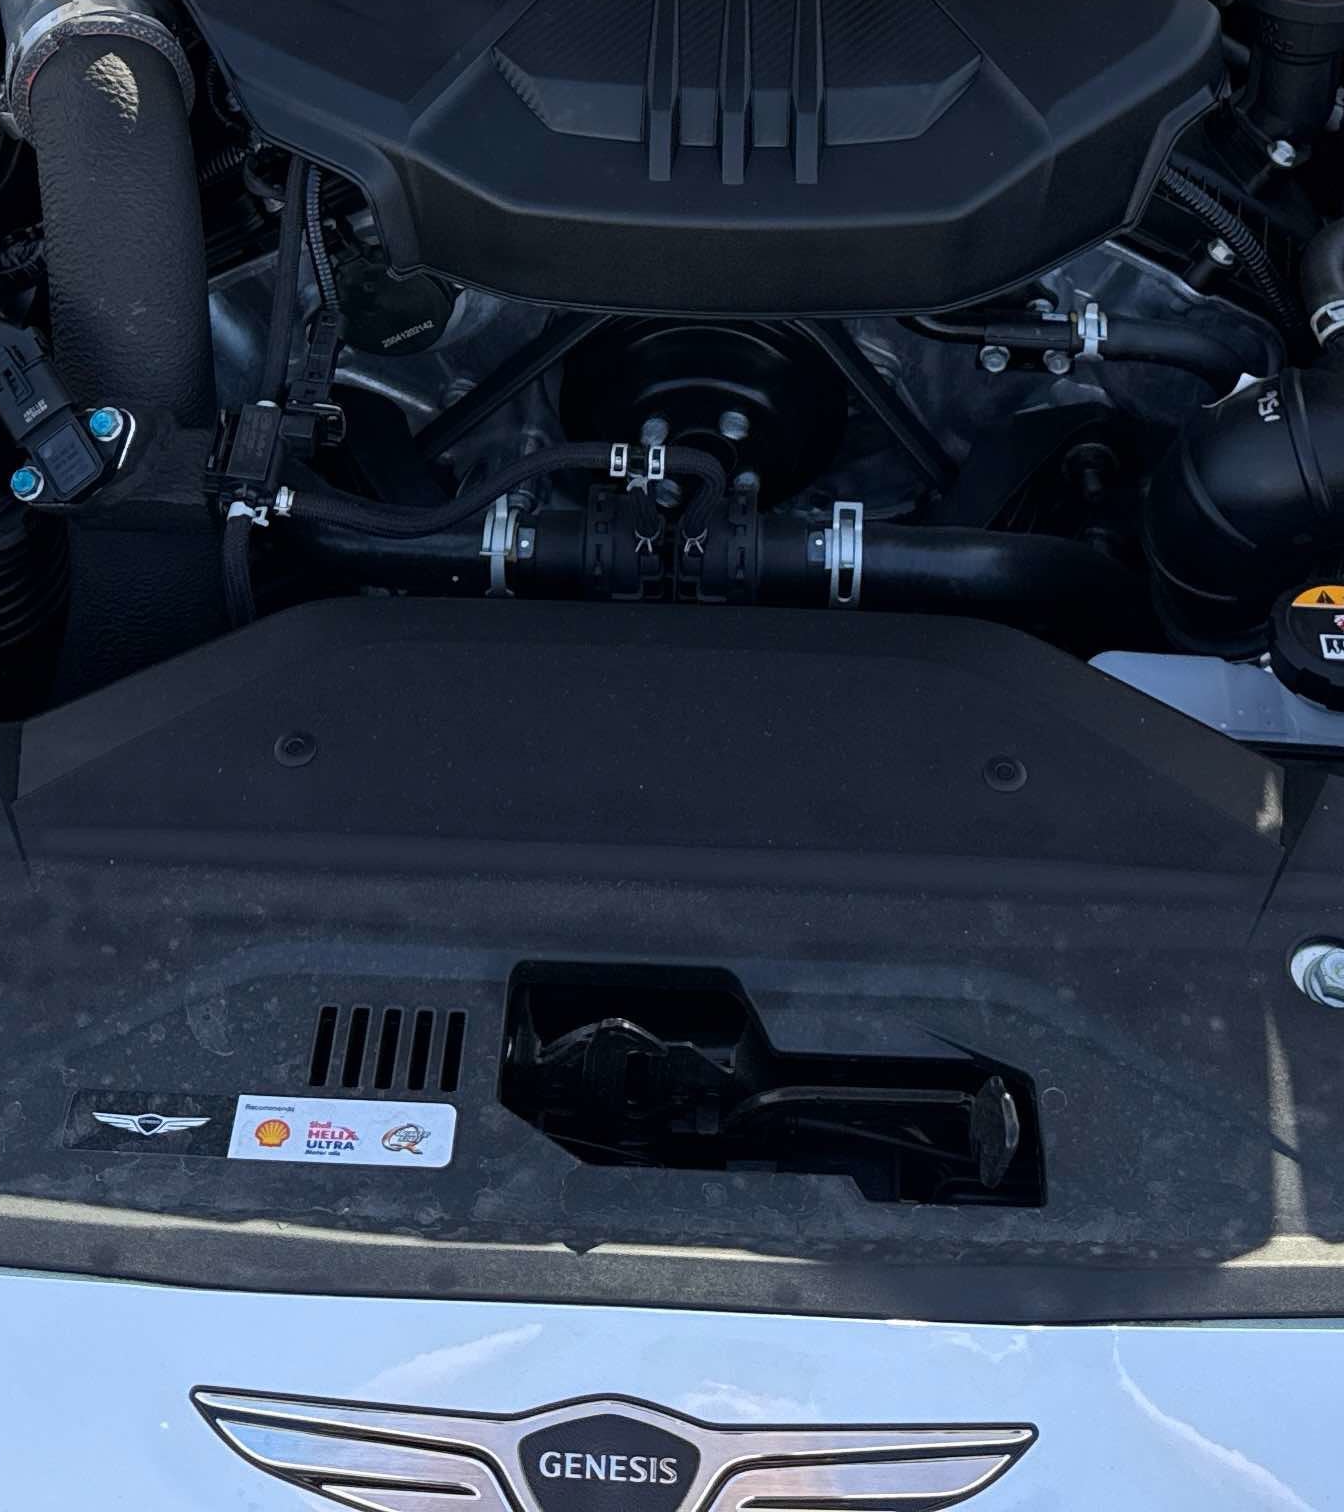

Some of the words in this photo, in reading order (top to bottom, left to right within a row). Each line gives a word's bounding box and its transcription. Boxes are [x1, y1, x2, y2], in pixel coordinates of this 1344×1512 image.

[308, 1128, 360, 1141] HELIX
[306, 1140, 355, 1150] ULTRA
[539, 1450, 678, 1484] GENESIS
